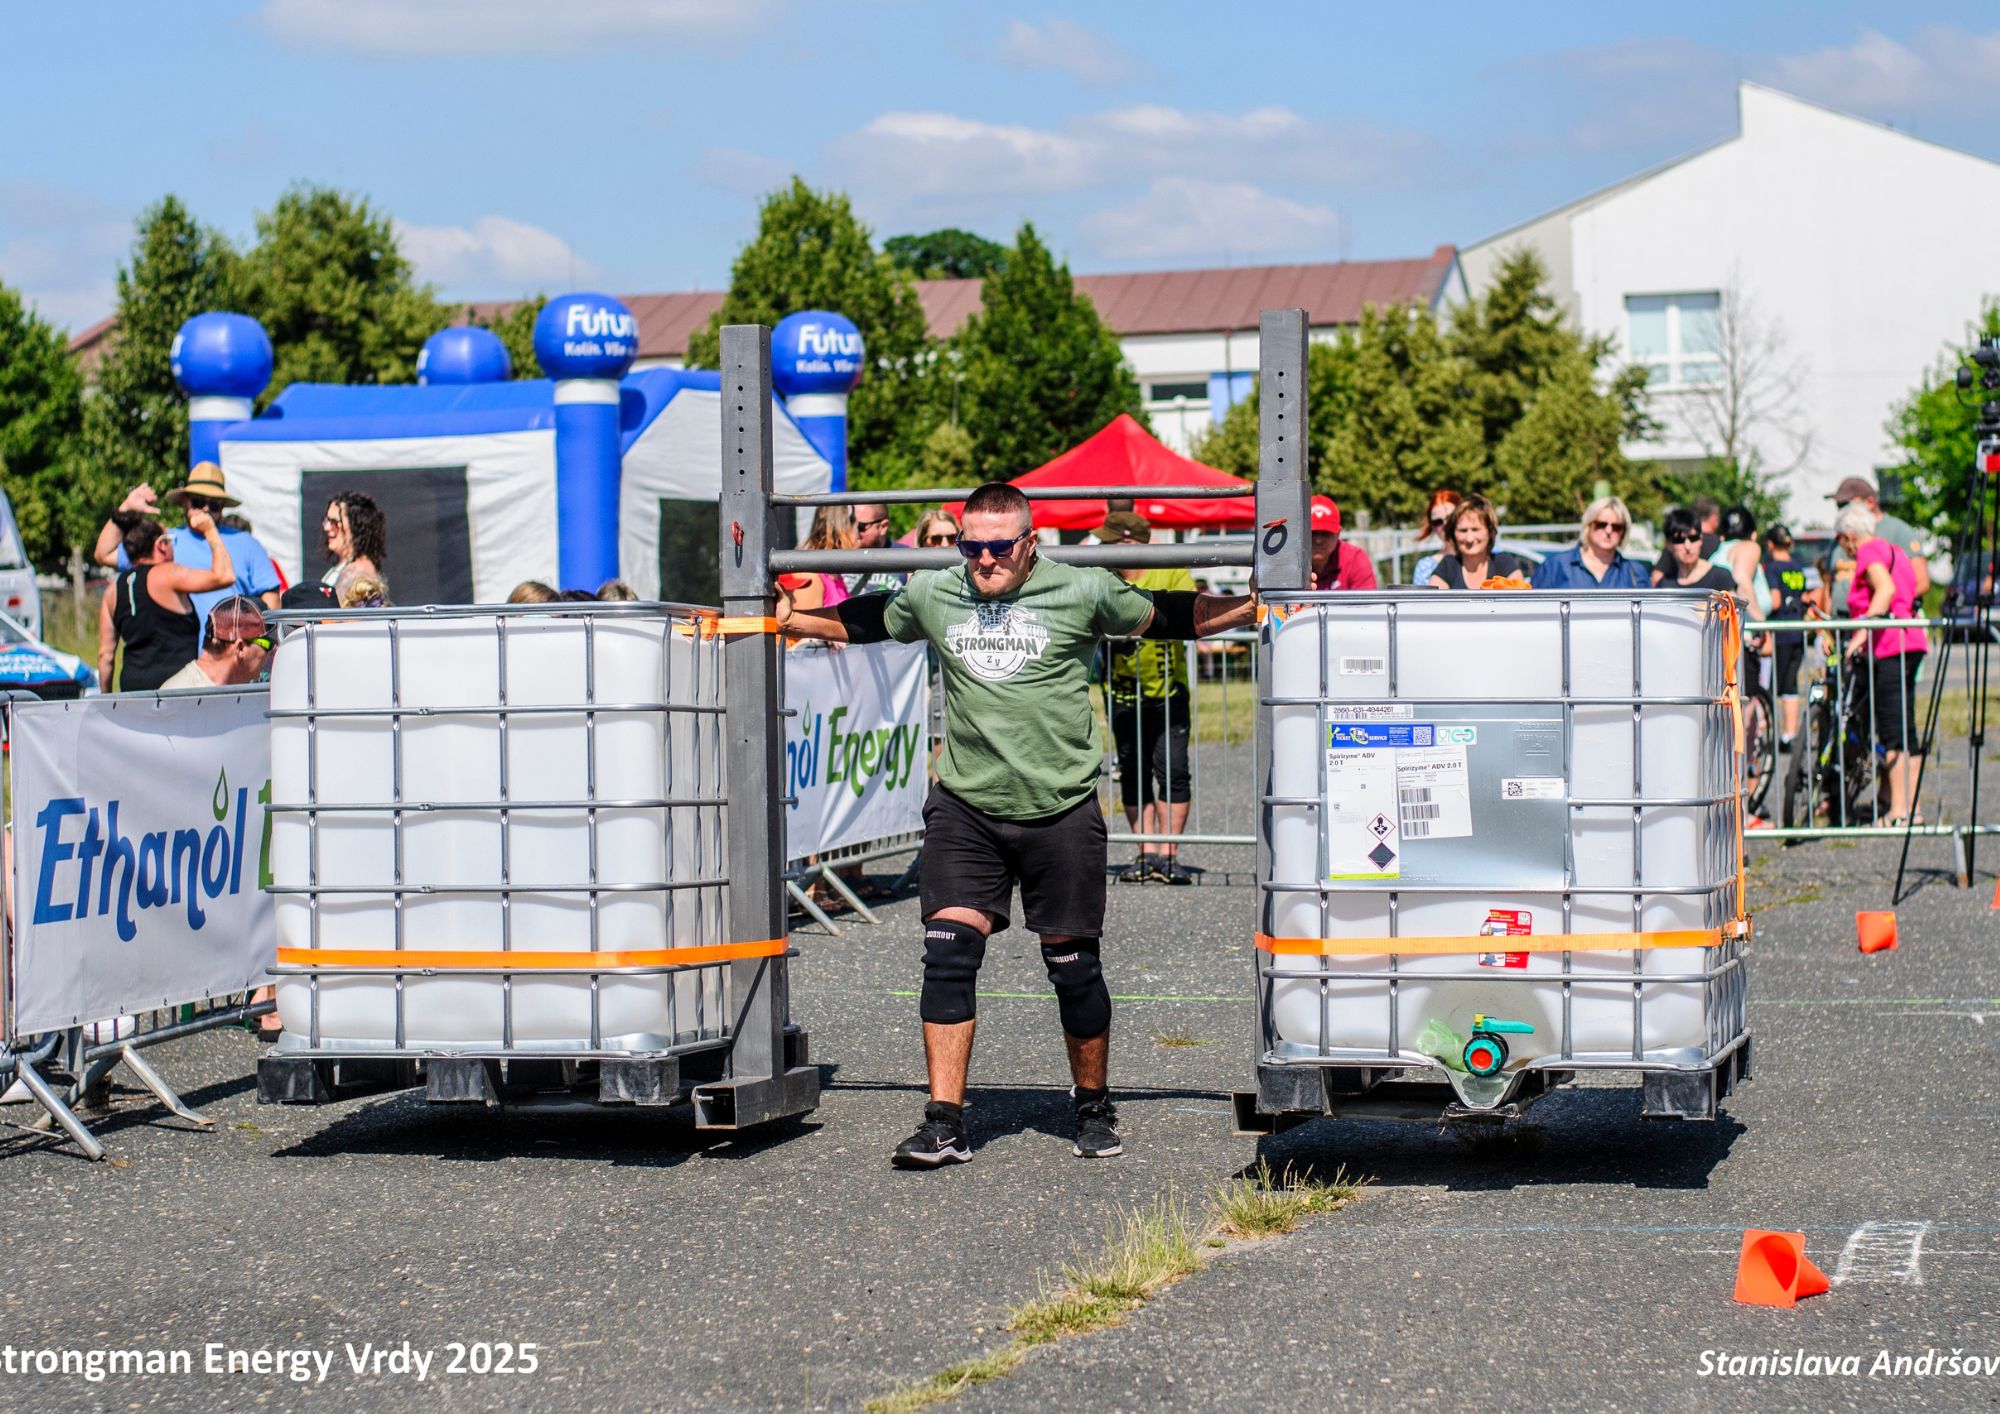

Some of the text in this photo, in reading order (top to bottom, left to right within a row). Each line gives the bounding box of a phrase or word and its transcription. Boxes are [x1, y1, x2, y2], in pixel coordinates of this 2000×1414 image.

[955, 637, 1039, 655] STRONGMAN
[826, 706, 920, 798] Energy
[33, 786, 248, 942] Ethanol
